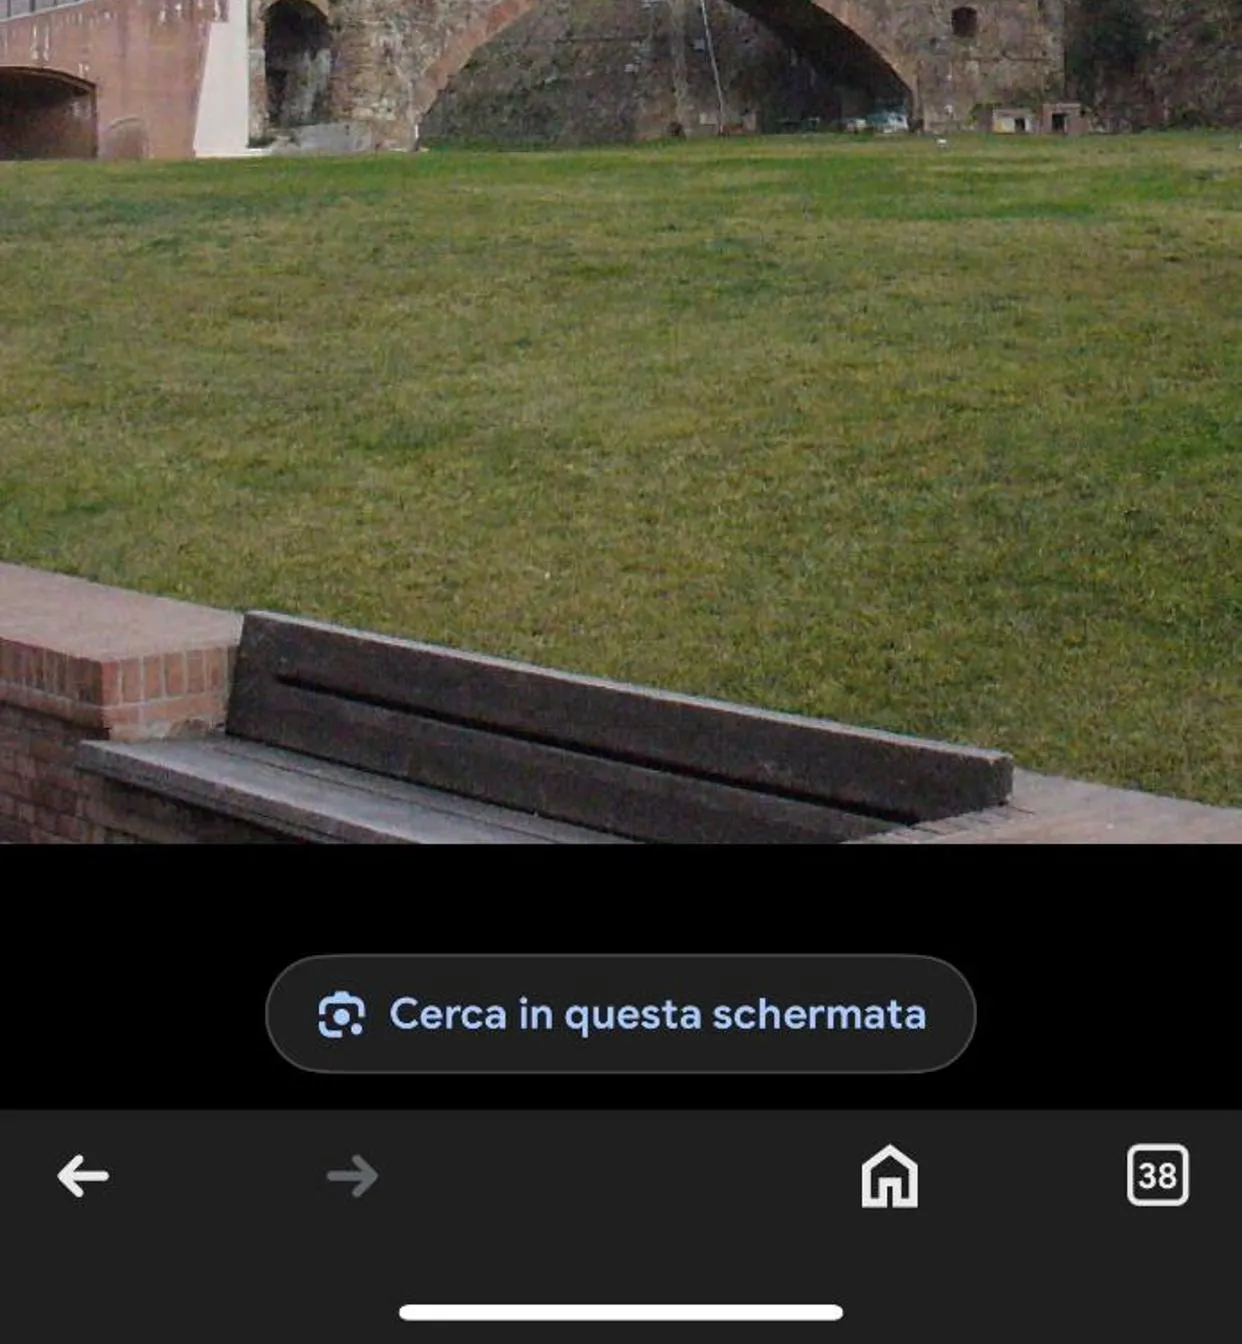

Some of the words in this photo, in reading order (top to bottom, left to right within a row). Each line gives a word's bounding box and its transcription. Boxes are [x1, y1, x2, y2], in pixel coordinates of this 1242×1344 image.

[389, 996, 507, 1030] Cerca
[519, 995, 553, 1030] in
[564, 999, 702, 1039] questa
[713, 997, 926, 1030] schermata
[1138, 1162, 1178, 1191] 38
